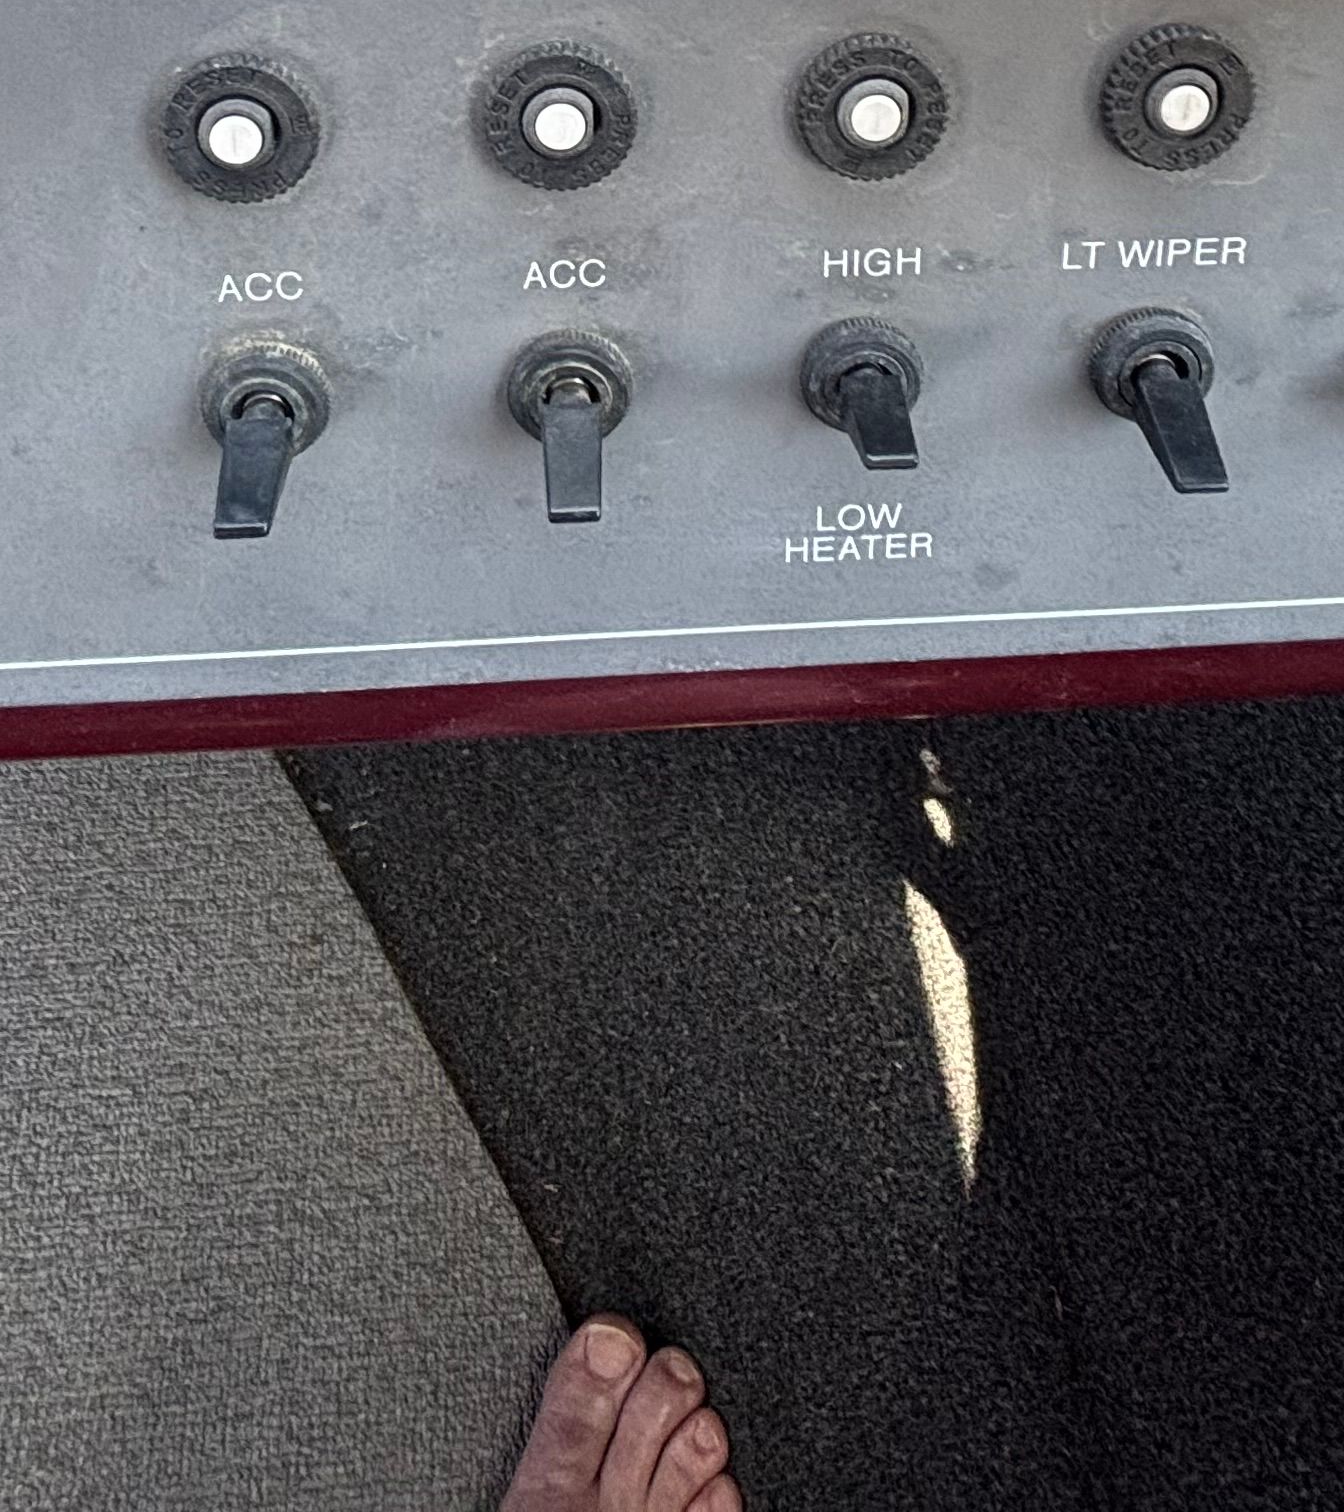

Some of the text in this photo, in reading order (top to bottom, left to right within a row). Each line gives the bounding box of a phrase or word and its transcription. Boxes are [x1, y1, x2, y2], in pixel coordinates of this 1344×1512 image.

[172, 66, 264, 112] RESET
[488, 68, 530, 157] RESET
[822, 247, 923, 278] HIGH
[1062, 236, 1248, 271] LT WIPER
[218, 271, 304, 303] ACC
[524, 258, 607, 290] ACC
[816, 502, 904, 532] LOW
[784, 531, 933, 564] HEATER
